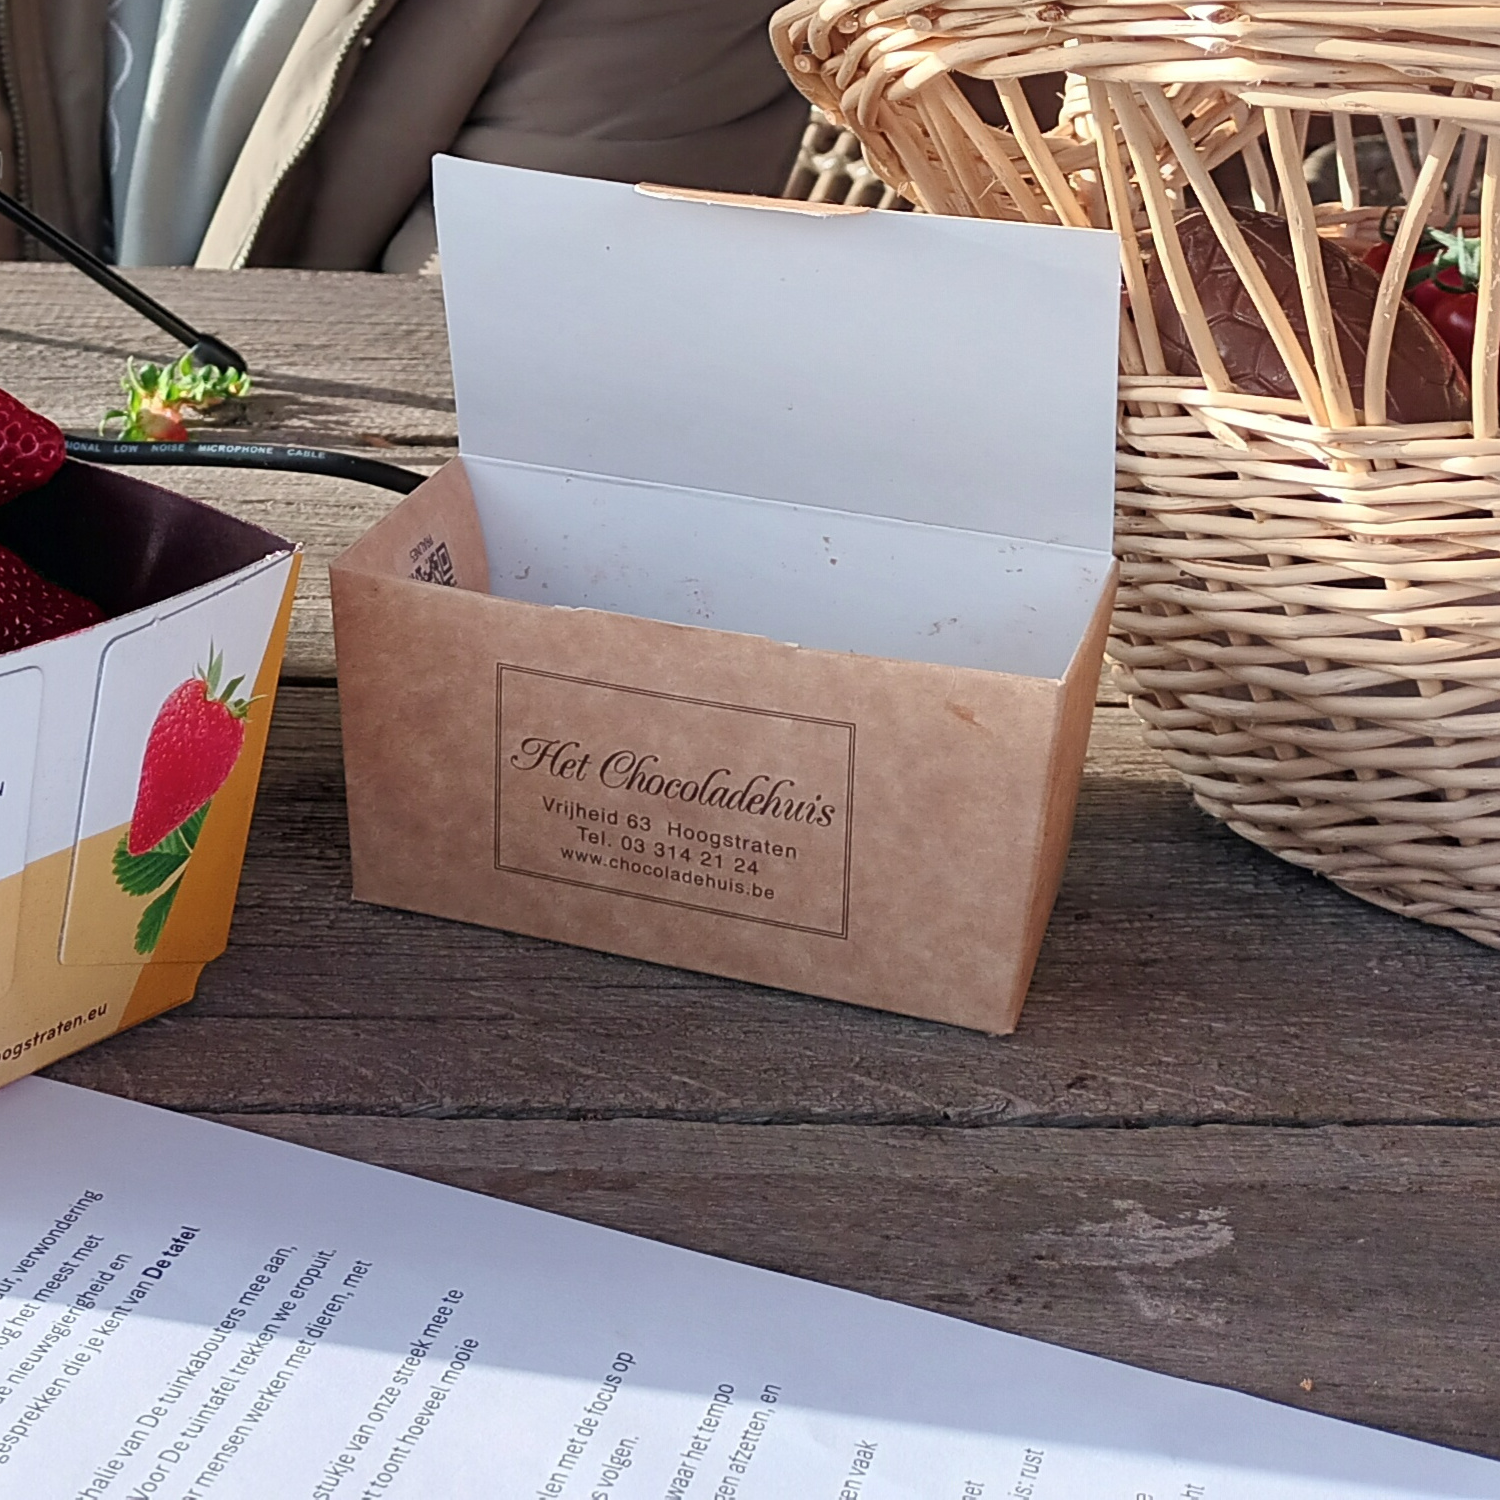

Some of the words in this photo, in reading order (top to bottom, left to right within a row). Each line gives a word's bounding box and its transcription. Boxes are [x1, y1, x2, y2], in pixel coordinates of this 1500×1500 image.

[65, 440, 101, 453] SIONAL
[113, 444, 138, 453] LOW
[151, 443, 185, 452] NOISE
[198, 444, 274, 456] MICROPHONE
[287, 448, 326, 460] CABLE
[509, 736, 593, 782] Het
[599, 750, 836, 828] Chocoladehuis
[542, 796, 619, 825] Vrijheid
[626, 812, 652, 833] 63
[667, 821, 797, 861] Hoogstraten
[576, 825, 612, 847] Tel.
[620, 834, 646, 854] 03
[653, 842, 692, 863] 314
[700, 851, 724, 869] 21
[733, 858, 760, 876] 24
[560, 846, 776, 901] www.chocoladehuis.be
[11, 1190, 103, 1273] verwondering
[12, 1302, 40, 1328] het
[32, 1261, 80, 1302] meest
[71, 1234, 104, 1261] met
[62, 1353, 92, 1376] die
[78, 1337, 105, 1355] je
[92, 1304, 133, 1336] kent
[127, 1280, 154, 1314] van
[141, 1260, 172, 1279] De
[162, 1226, 201, 1257] tafel
[6, 1270, 115, 1384] nieuwsgierigheid
[109, 1254, 132, 1270] en
[75, 1460, 124, 1500] halie
[115, 1430, 149, 1456] van
[136, 1407, 168, 1428] De
[158, 1308, 246, 1404] tuinkabouters
[238, 1275, 271, 1306] mee
[264, 1247, 297, 1273] aan,
[158, 1442, 190, 1463] De
[180, 1376, 240, 1438] tuintafel
[229, 1324, 281, 1375] trekken
[271, 1301, 297, 1321] we
[290, 1250, 337, 1299] eropuit.
[195, 1426, 253, 1487] mensen
[242, 1371, 294, 1423] werken
[285, 1339, 316, 1369] met
[305, 1292, 354, 1338] dieren,
[343, 1260, 372, 1288] met
[612, 1352, 636, 1372] op
[313, 1454, 355, 1500] stukje
[345, 1425, 376, 1450] van
[367, 1387, 401, 1422] onze
[393, 1339, 433, 1385] streek
[422, 1306, 453, 1338] mee
[441, 1290, 464, 1304] te
[369, 1446, 411, 1488] toont
[396, 1385, 451, 1445] hoeveel
[441, 1339, 479, 1385] mooie
[584, 1374, 622, 1416] focus
[697, 1384, 734, 1433] tempo
[574, 1418, 599, 1436] de
[680, 1434, 712, 1461] het
[728, 1409, 775, 1474] afzetten,
[760, 1385, 781, 1403] en
[557, 1438, 588, 1470] met
[597, 1437, 639, 1487] volgen.
[665, 1461, 697, 1500] waar
[849, 1440, 878, 1475] vaak
[1020, 1448, 1044, 1480] rust
[536, 1473, 568, 1500] len
